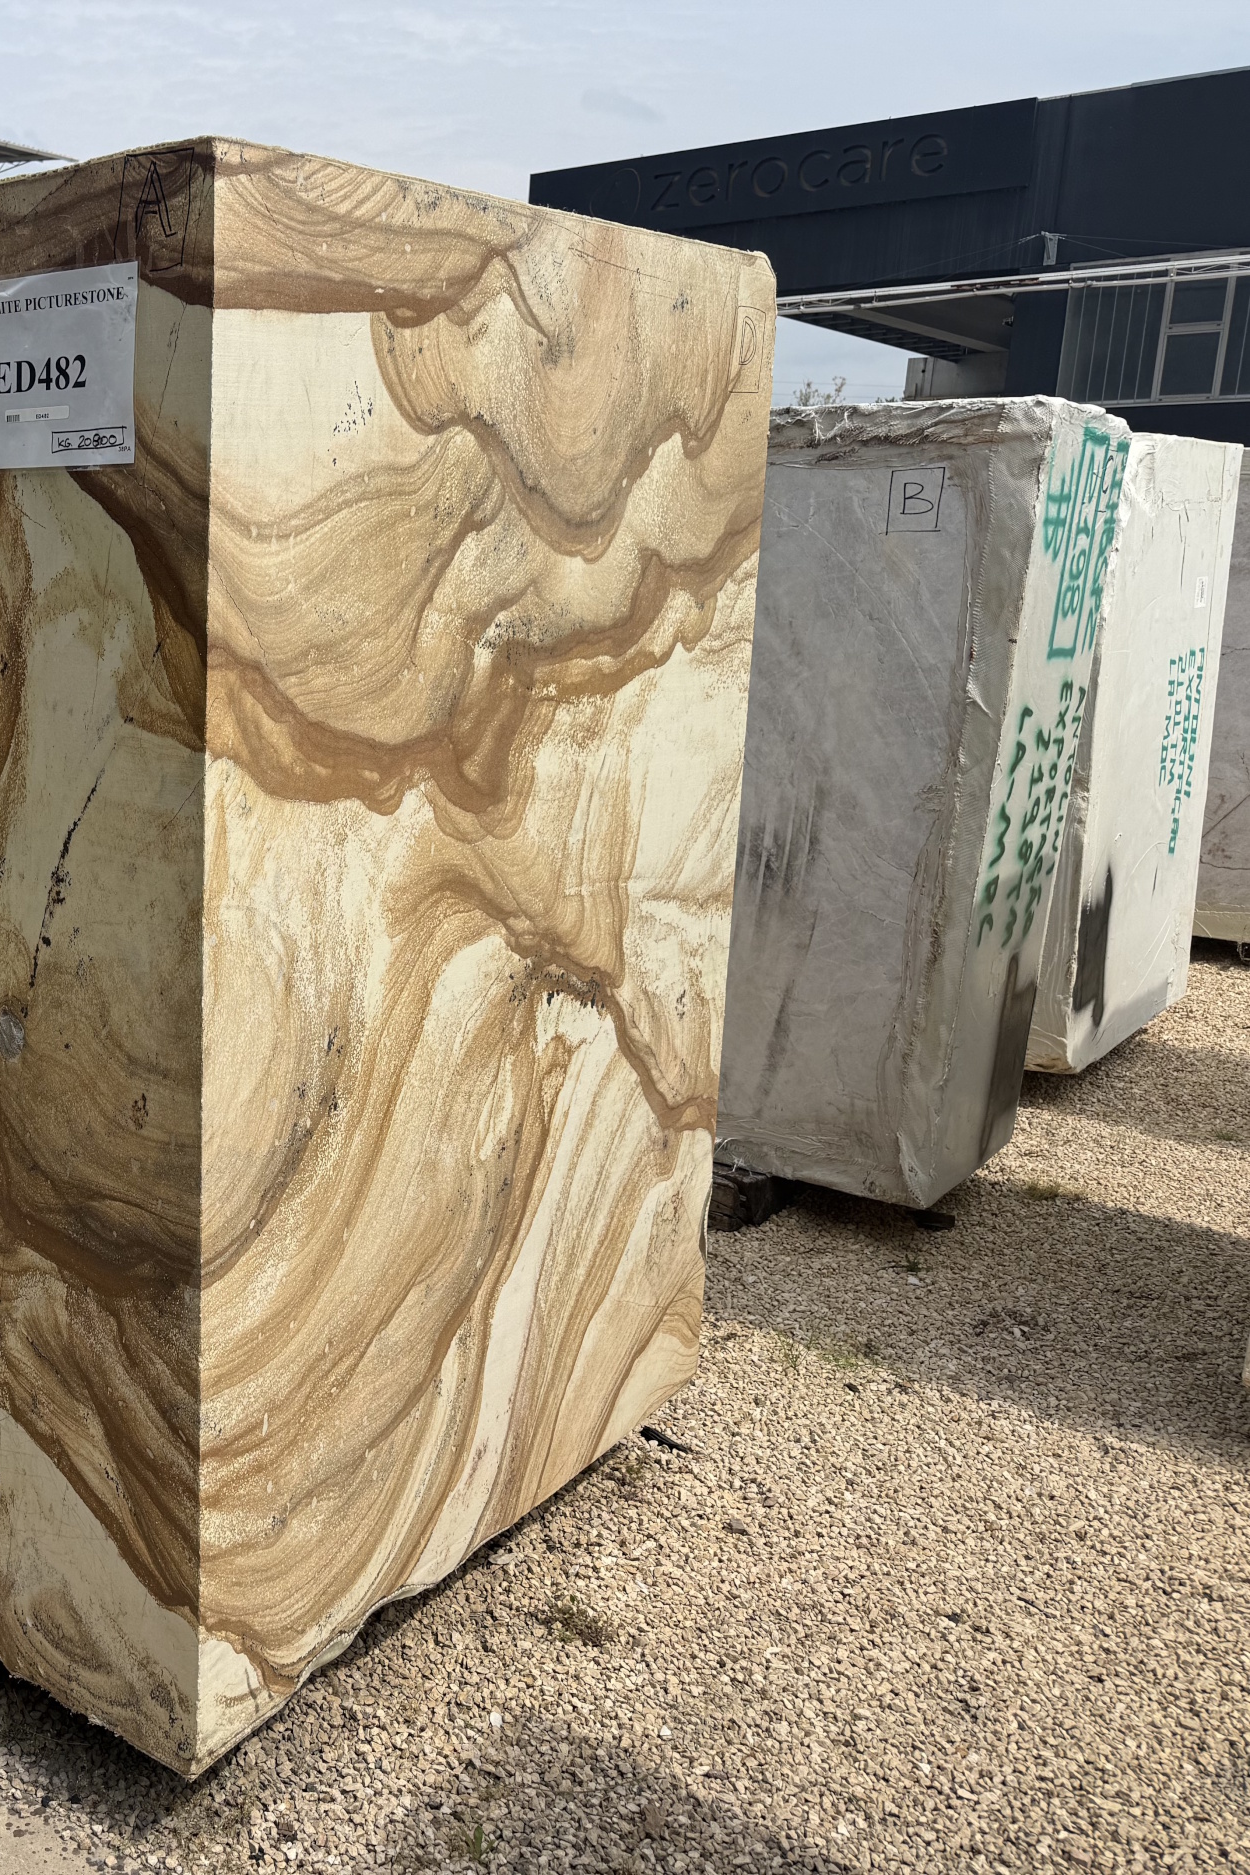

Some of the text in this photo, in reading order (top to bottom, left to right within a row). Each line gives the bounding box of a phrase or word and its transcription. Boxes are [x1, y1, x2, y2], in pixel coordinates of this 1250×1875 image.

[135, 160, 177, 238] A
[649, 131, 949, 212] zerocare
[25, 286, 125, 312] PICTURESTONE
[901, 481, 935, 516] B
[1183, 646, 1206, 799] ANTOLINI
[1046, 685, 1086, 876] ANTOLINI
